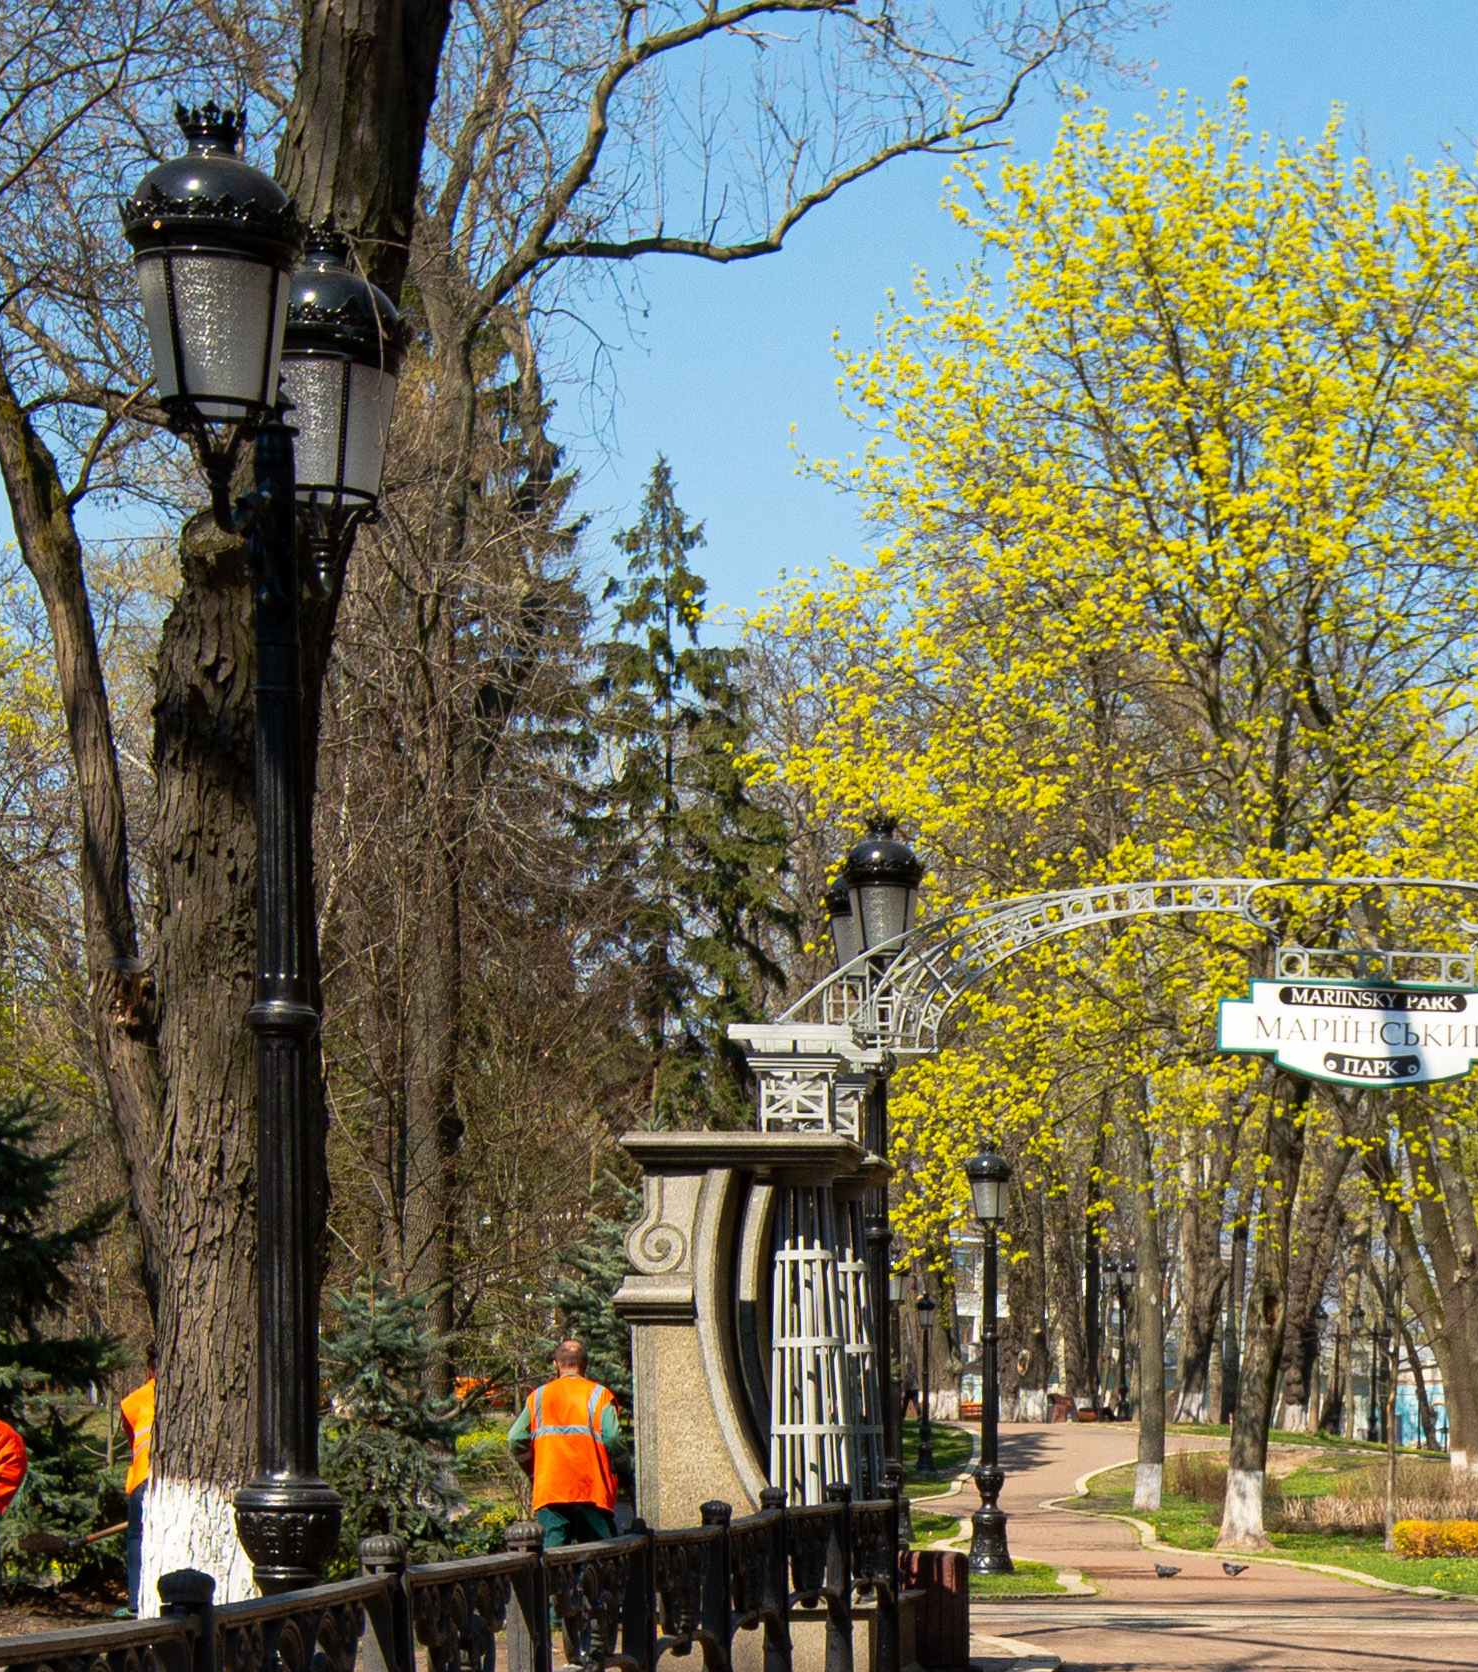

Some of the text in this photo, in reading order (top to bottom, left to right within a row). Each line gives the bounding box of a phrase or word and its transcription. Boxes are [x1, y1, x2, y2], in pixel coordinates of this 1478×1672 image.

[1290, 987, 1458, 1011] MARIINSKY PARK
[1341, 1057, 1399, 1076] ПАРК
